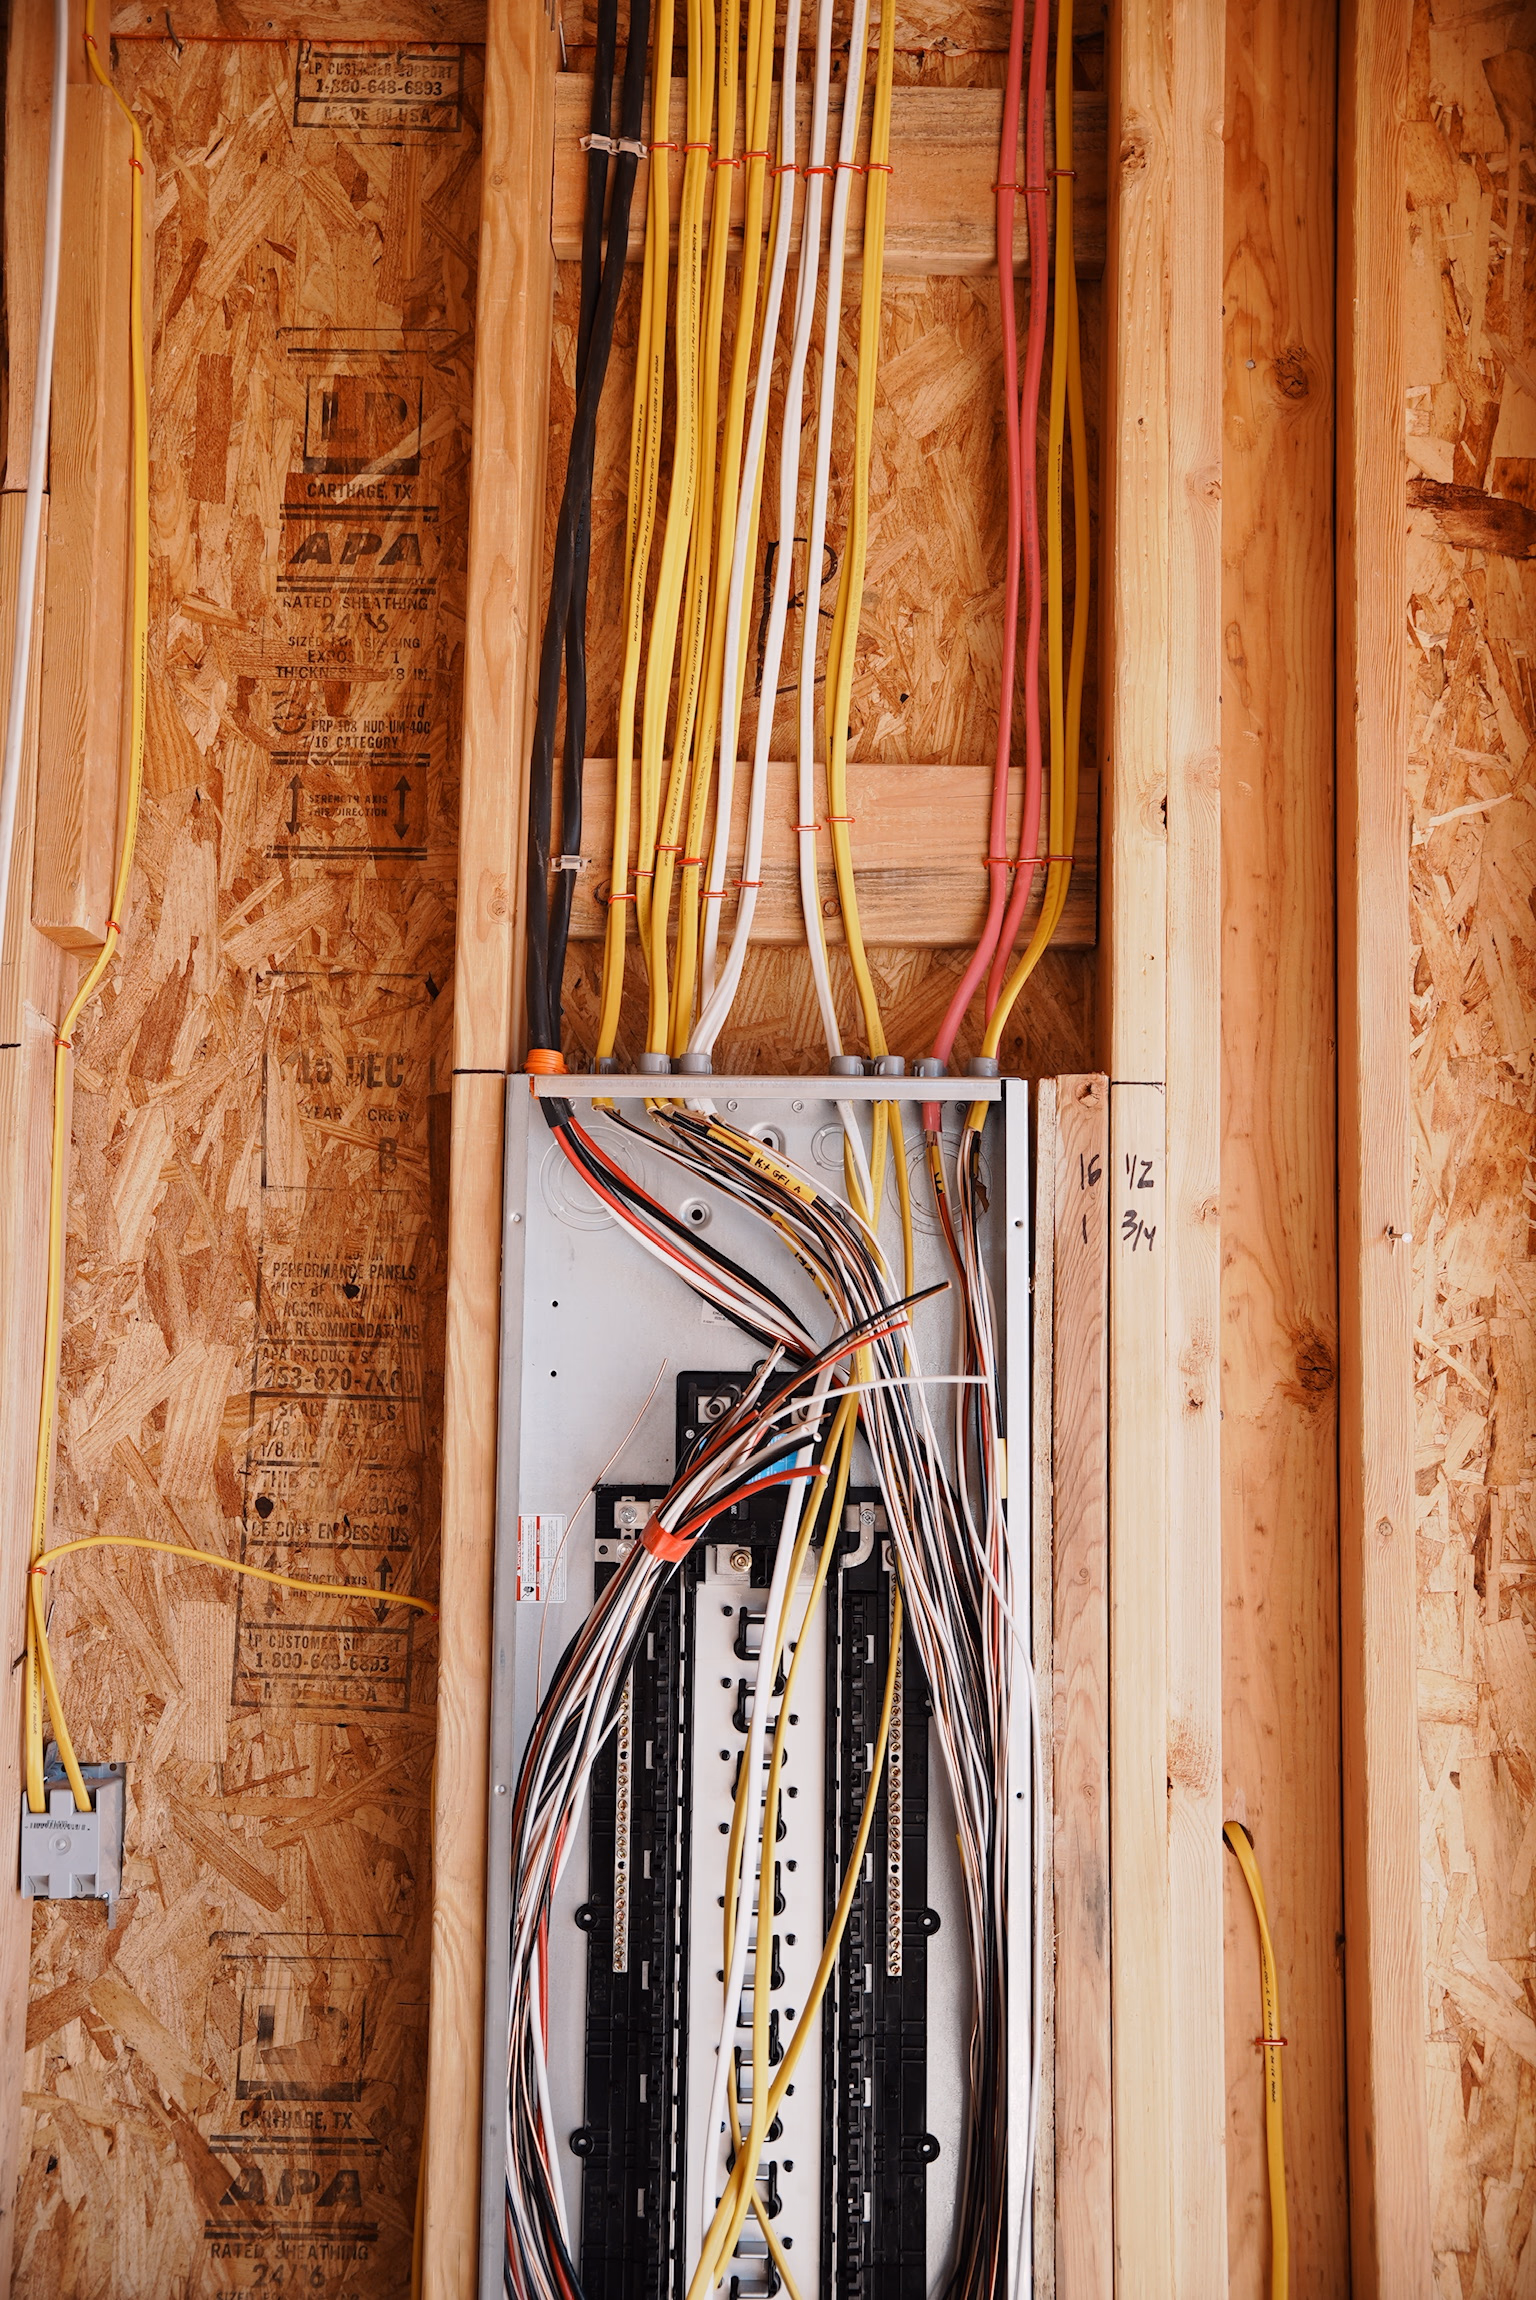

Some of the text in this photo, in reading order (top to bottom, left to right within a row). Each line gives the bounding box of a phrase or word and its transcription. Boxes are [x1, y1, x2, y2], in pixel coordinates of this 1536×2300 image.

[393, 484, 415, 500] TX
[289, 532, 423, 566] APA
[283, 597, 429, 610] RATED SHEATHING
[336, 736, 400, 749] CATEGORY
[304, 1105, 343, 1121] YEAR
[1080, 1152, 1155, 1190] 16 1/2
[1121, 1209, 1157, 1252] 3/4
[334, 2111, 353, 2130] TX
[218, 2167, 363, 2208] APA
[211, 2241, 369, 2261] RATED SHEATHING
